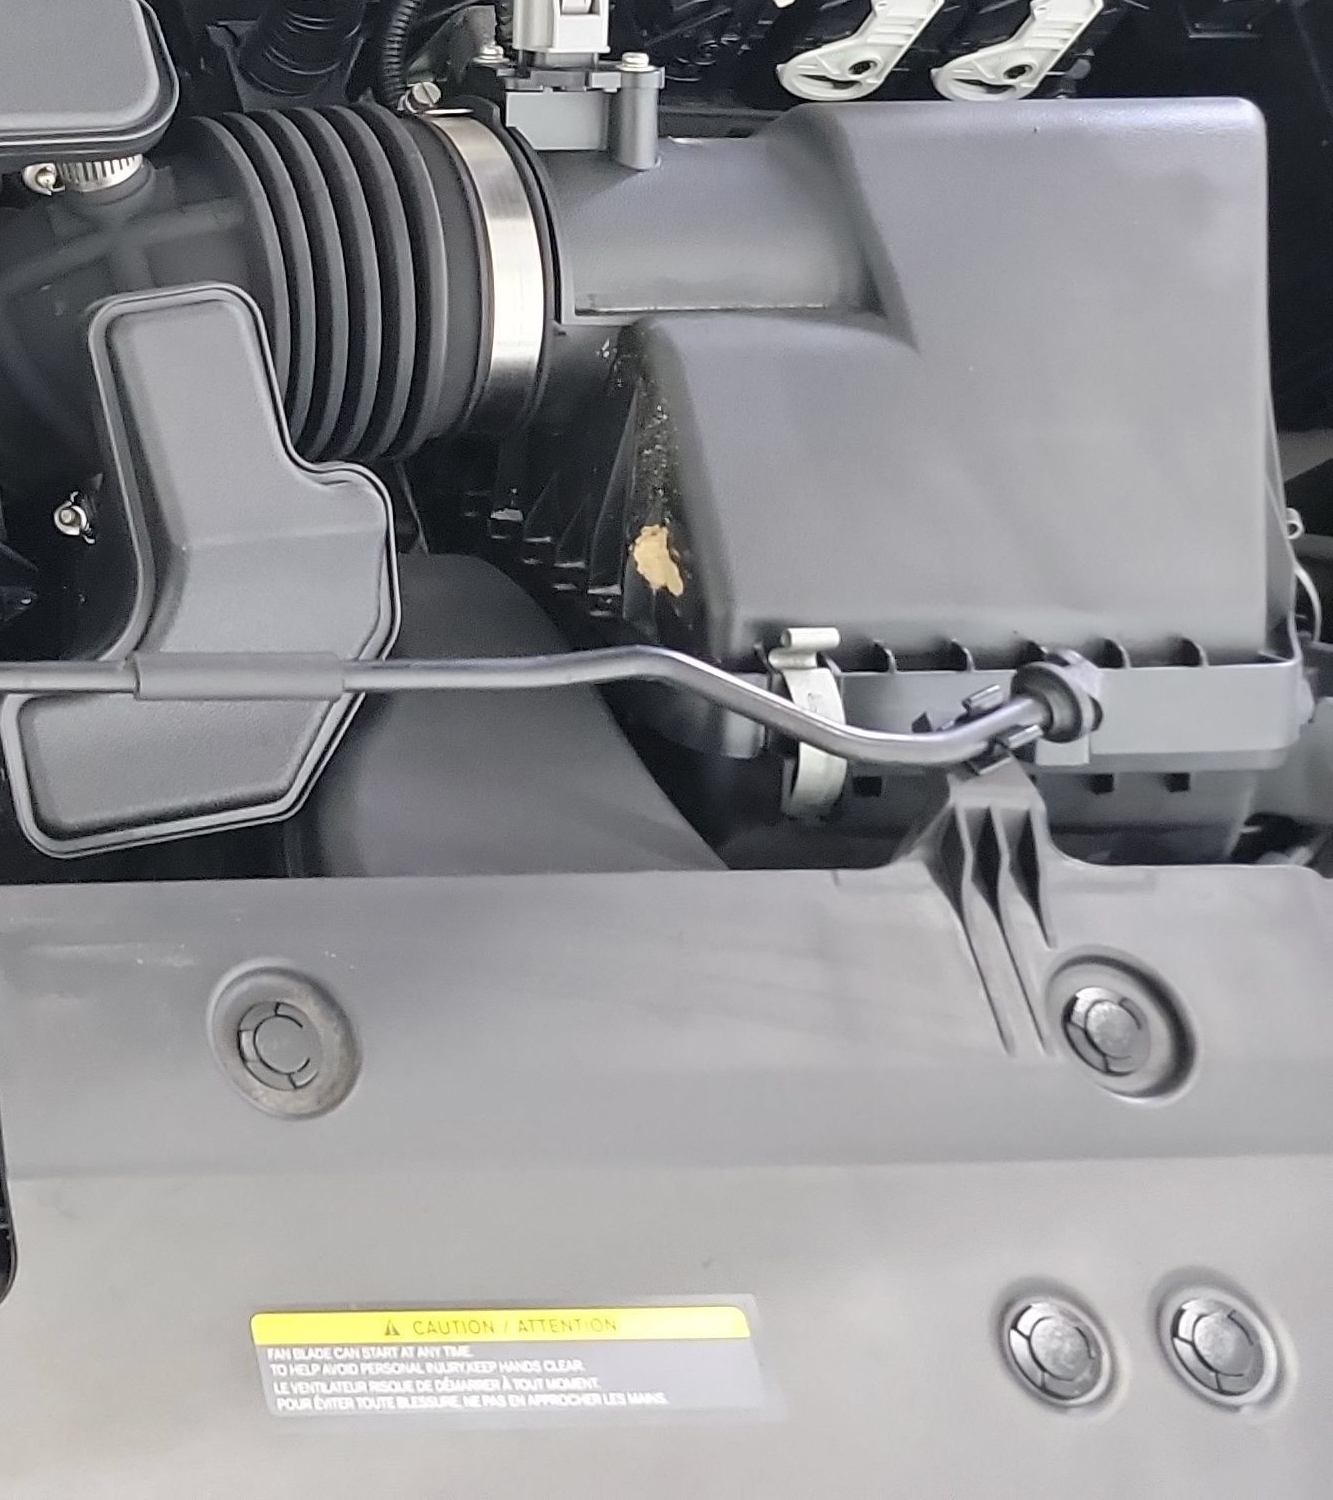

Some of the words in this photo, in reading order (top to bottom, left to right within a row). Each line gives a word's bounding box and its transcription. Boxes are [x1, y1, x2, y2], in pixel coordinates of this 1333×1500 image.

[413, 1320, 494, 1335] CAUTION
[518, 1318, 617, 1333] ATTENTION
[267, 1347, 291, 1360] FAN
[293, 1347, 332, 1359] BLADE
[336, 1347, 360, 1359] CAN
[362, 1346, 398, 1358] START
[401, 1346, 415, 1358] AT
[417, 1346, 441, 1358] ANY
[270, 1364, 288, 1376] TO
[289, 1363, 320, 1376] HELP
[322, 1363, 358, 1375] AVOID
[360, 1362, 424, 1374] PERSONAL
[499, 1359, 542, 1373] HANDS
[274, 1381, 289, 1394] LE
[291, 1381, 368, 1394] VENTILATEUR
[370, 1380, 413, 1393] RISQUE
[416, 1380, 433, 1392] DE
[513, 1378, 544, 1391] TOUT
[277, 1398, 312, 1411] POUR
[356, 1397, 395, 1410] TOUTE
[464, 1396, 481, 1408] NE
[483, 1394, 508, 1407] PAS
[510, 1394, 526, 1407] EN
[528, 1393, 603, 1406] APPROCHER
[604, 1393, 625, 1405] LES
